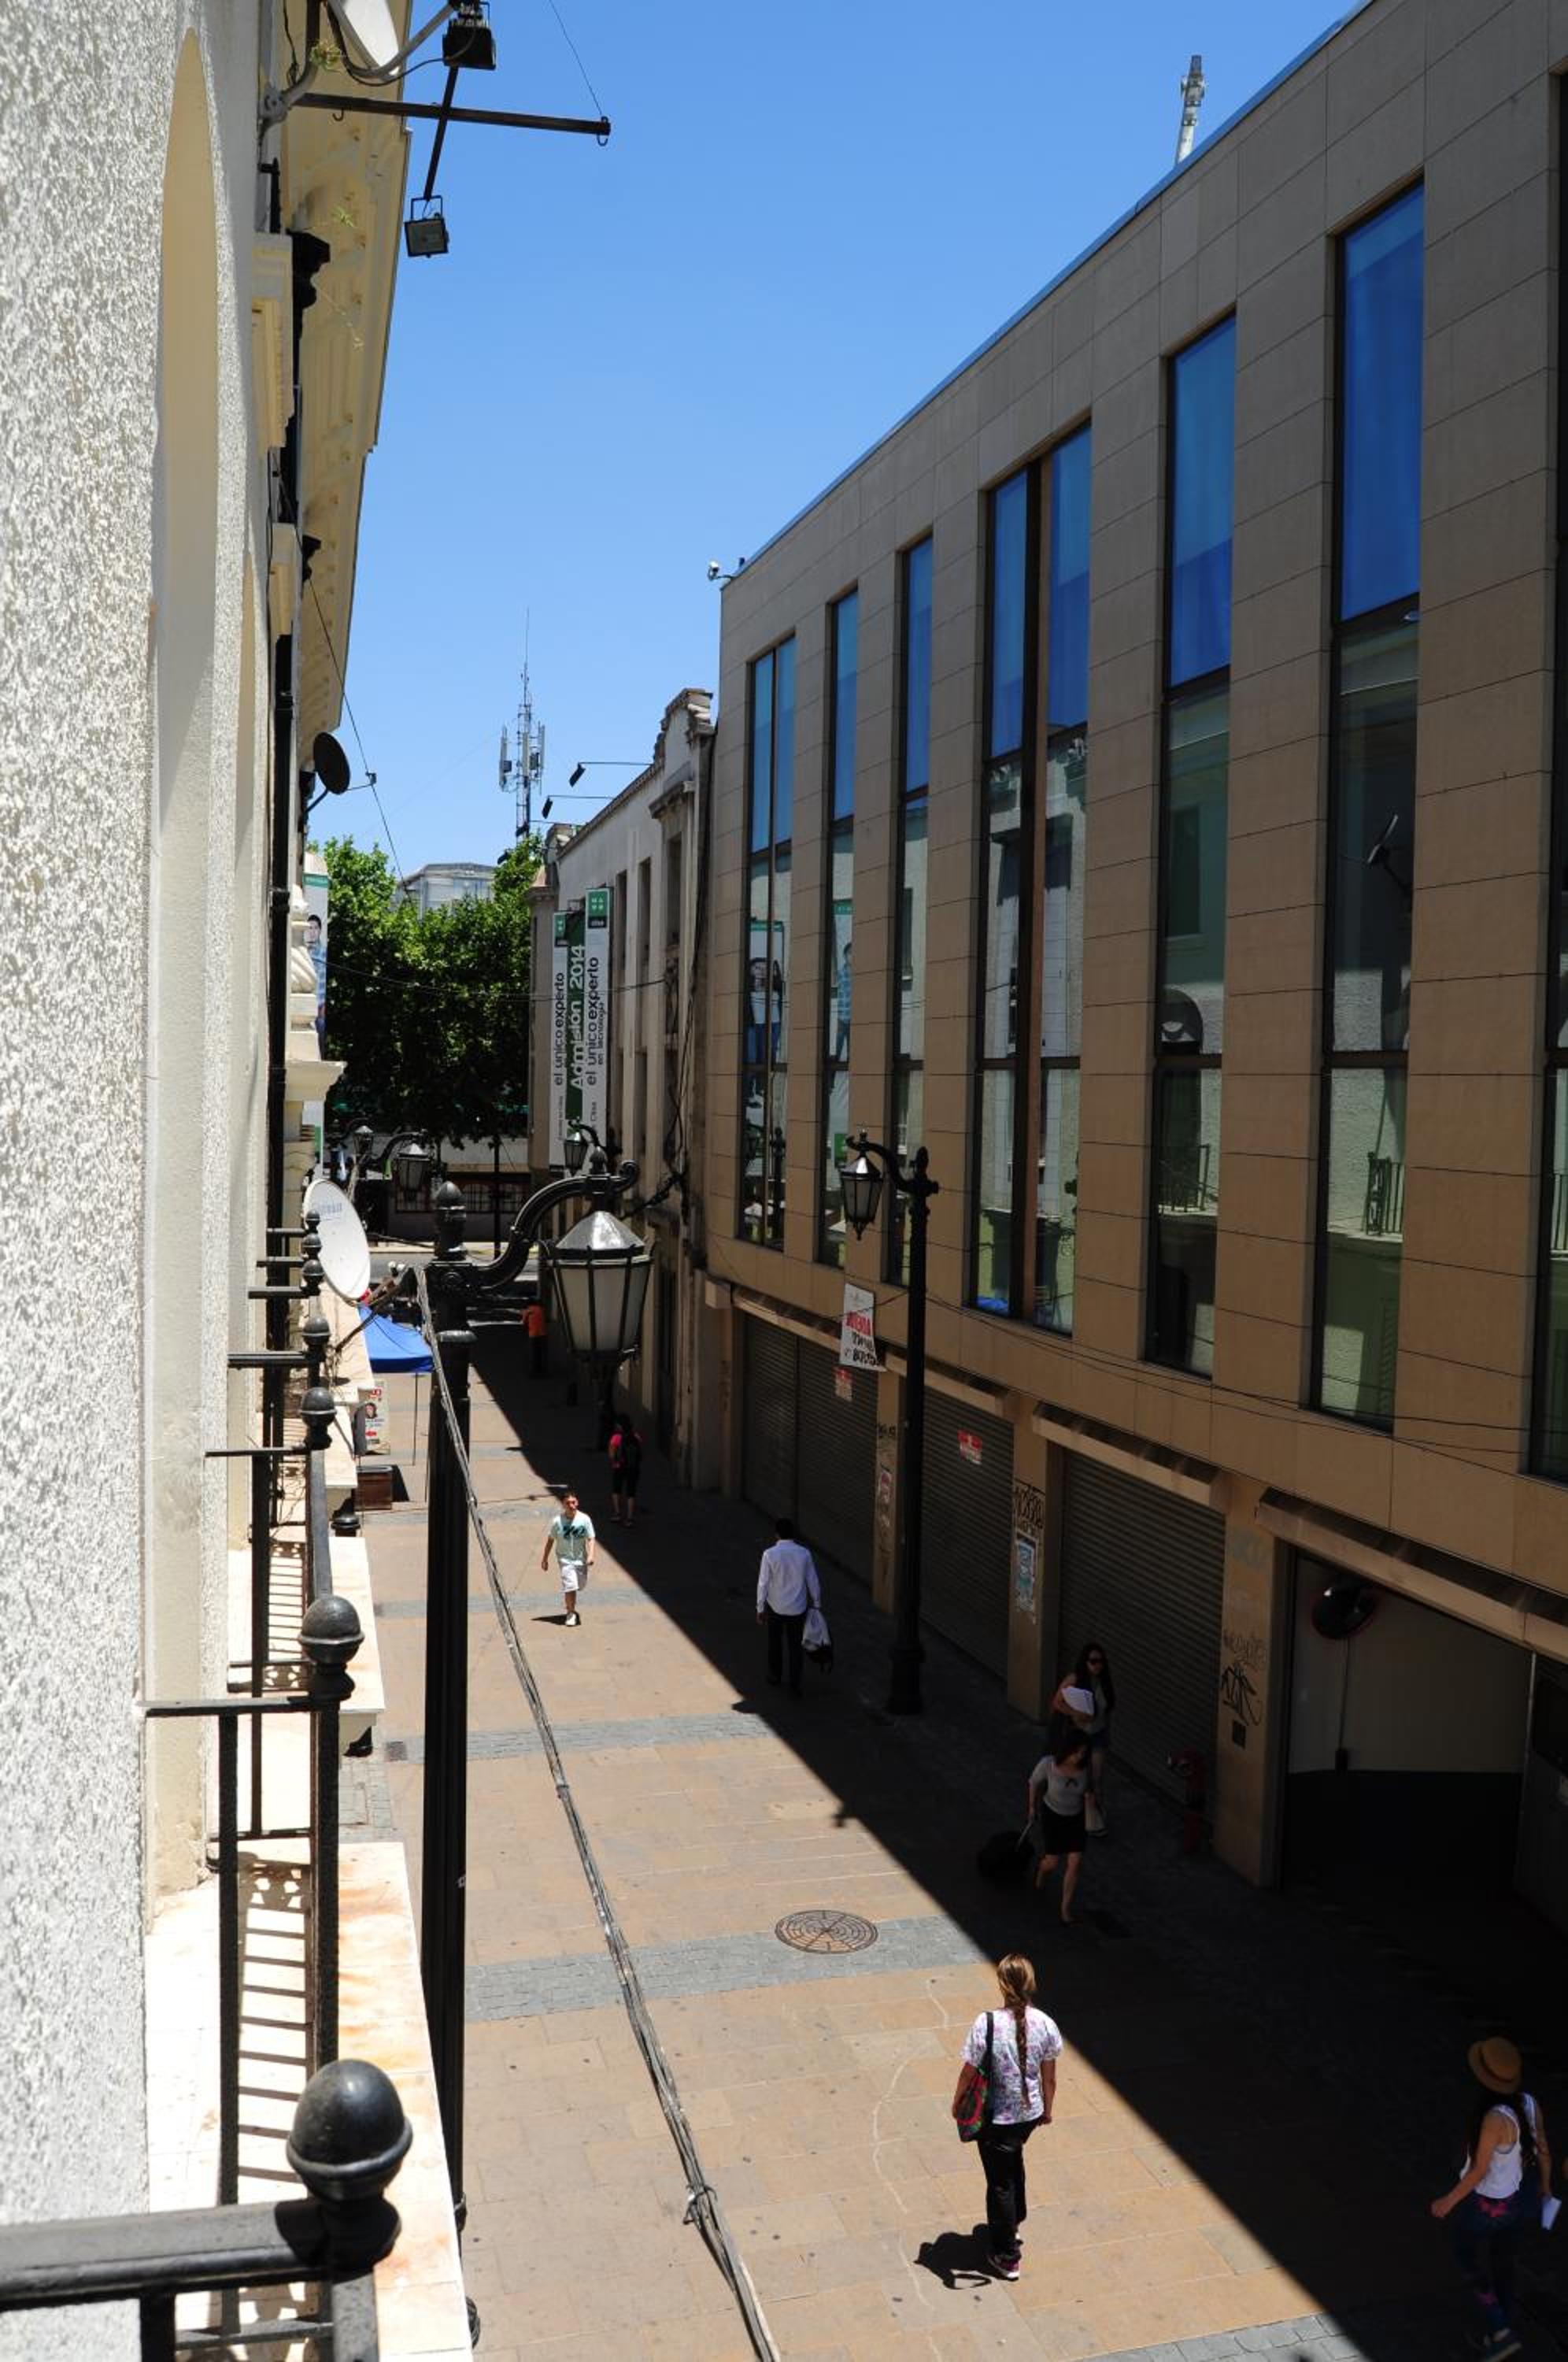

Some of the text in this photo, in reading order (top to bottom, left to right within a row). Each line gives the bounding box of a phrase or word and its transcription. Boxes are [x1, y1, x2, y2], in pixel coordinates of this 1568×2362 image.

[554, 972, 565, 1028] experto
[568, 944, 585, 1090] Admisión 2014
[586, 957, 600, 1086] el único experto
[553, 1029, 564, 1068] único
[553, 1073, 563, 1086] el
